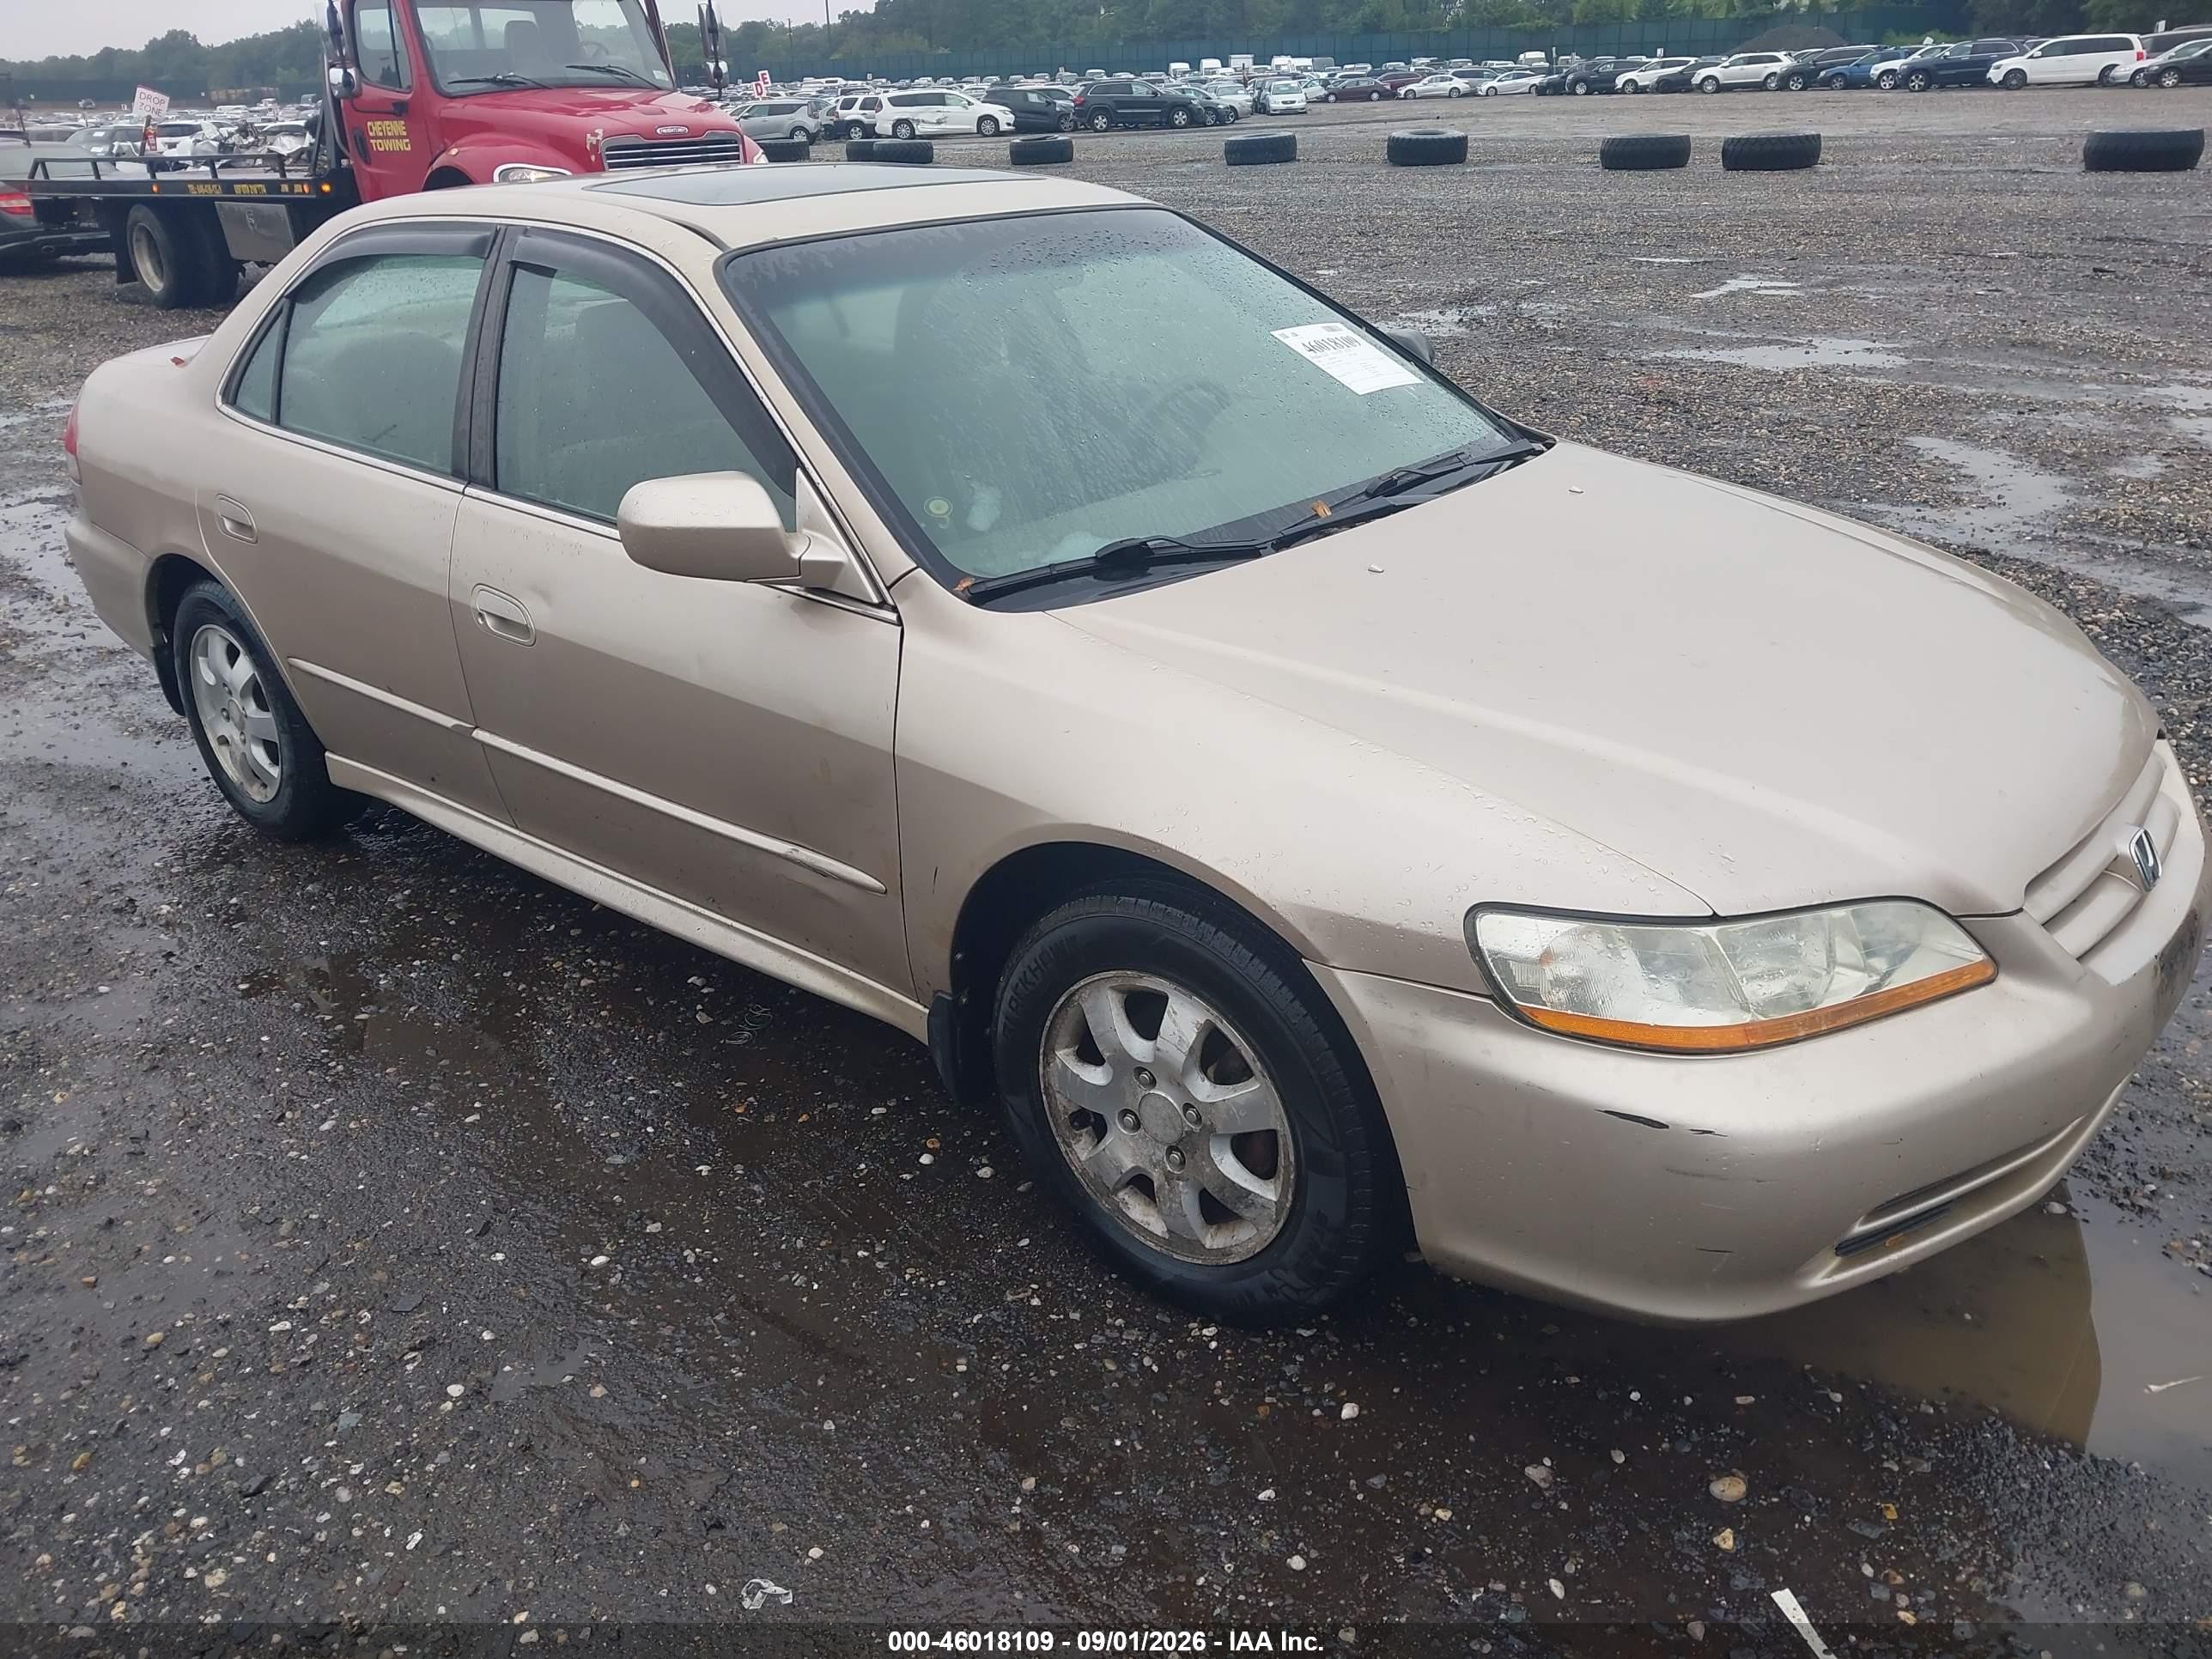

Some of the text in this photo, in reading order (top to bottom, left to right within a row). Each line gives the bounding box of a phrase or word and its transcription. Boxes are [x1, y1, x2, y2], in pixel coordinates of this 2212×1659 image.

[760, 72, 769, 85] E
[754, 82, 763, 96] D
[139, 92, 166, 106] DROP
[138, 101, 163, 118] ZONE
[367, 120, 407, 137] CHEYENNE
[369, 138, 411, 152] TOWING
[1301, 335, 1362, 354] 46018109
